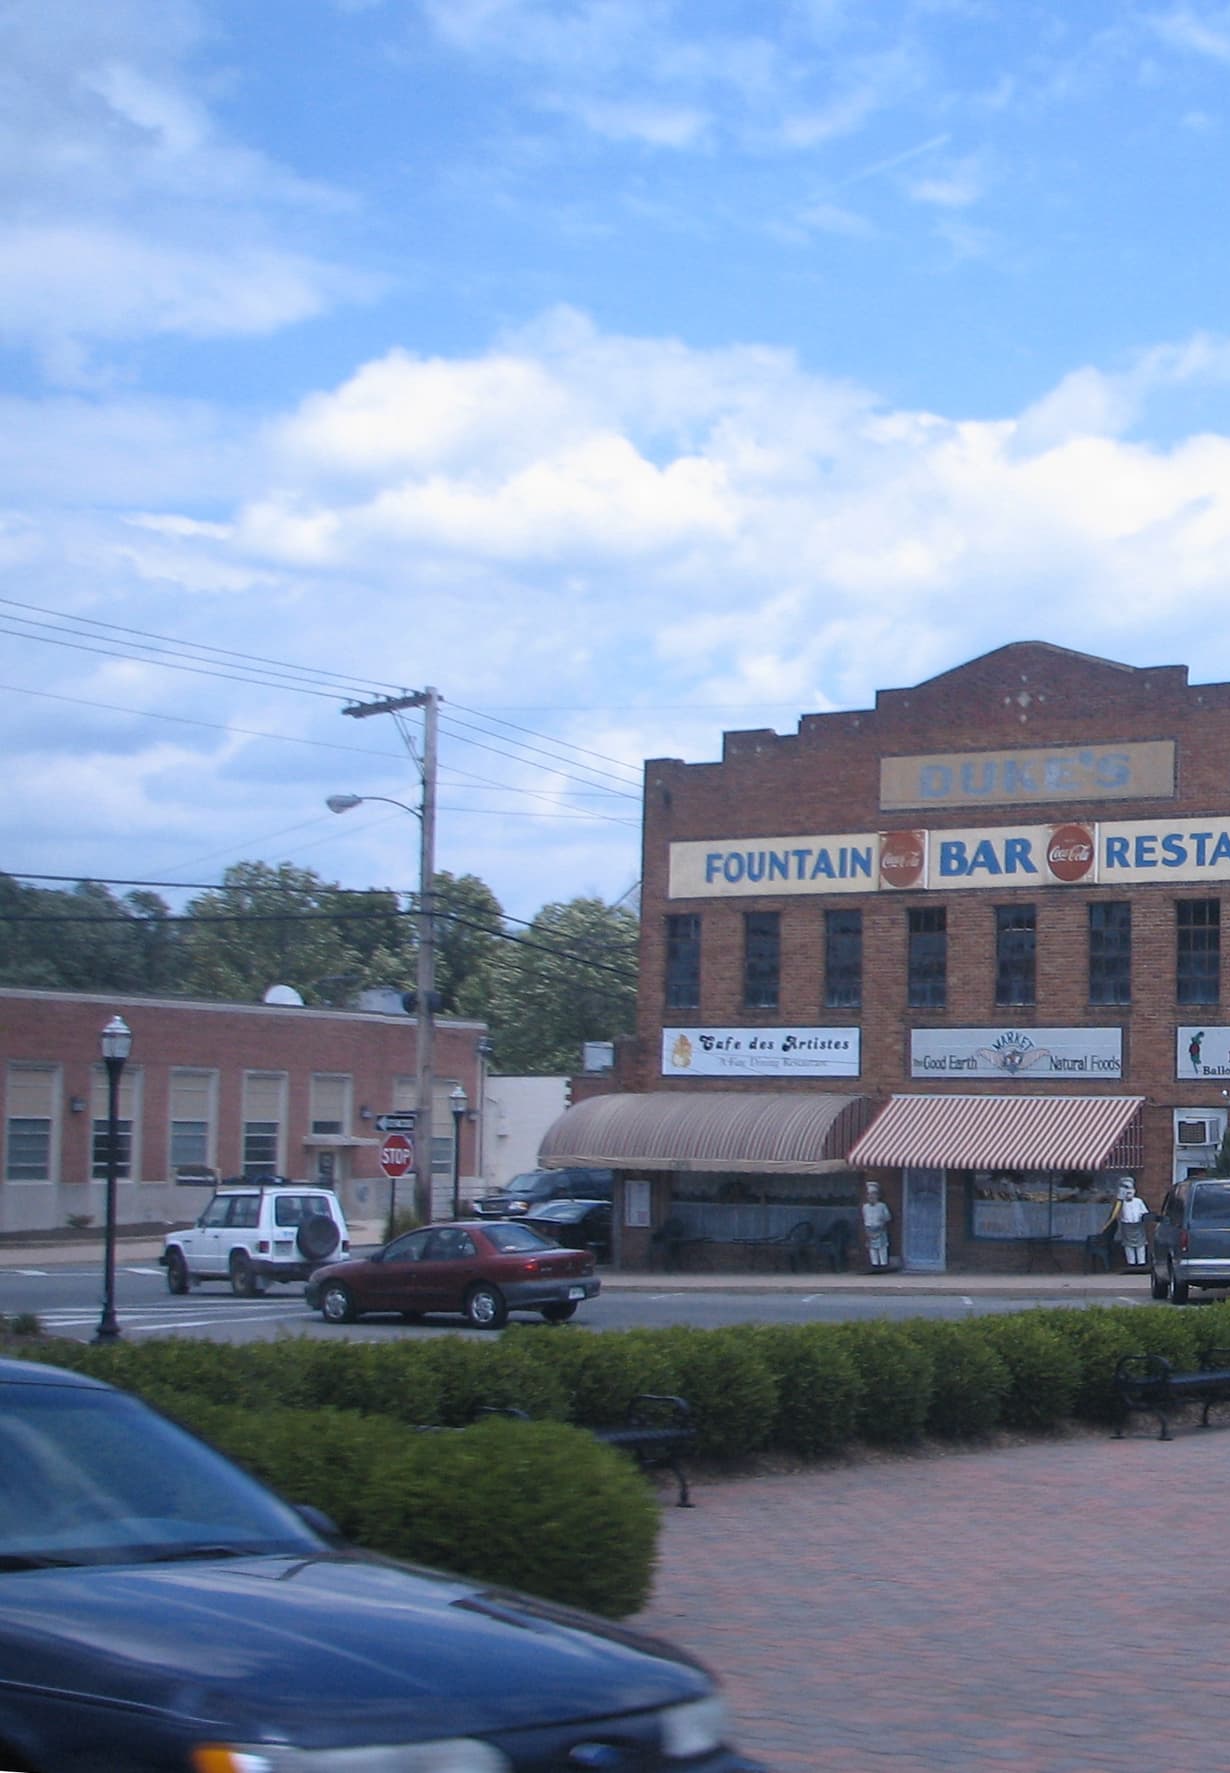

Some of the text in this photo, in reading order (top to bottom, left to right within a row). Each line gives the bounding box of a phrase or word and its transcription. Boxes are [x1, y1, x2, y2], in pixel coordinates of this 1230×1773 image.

[919, 751, 1132, 799] DUKE'S
[705, 847, 873, 884] FOUNTAIN
[939, 838, 1038, 876] BAR
[699, 1035, 850, 1052] Cafe des Artistes
[992, 1031, 1036, 1052] MARKET
[923, 1056, 947, 1070] Good
[949, 1055, 978, 1070] Earth
[1050, 1055, 1121, 1071] Natural Foods
[382, 1148, 410, 1165] STOP
